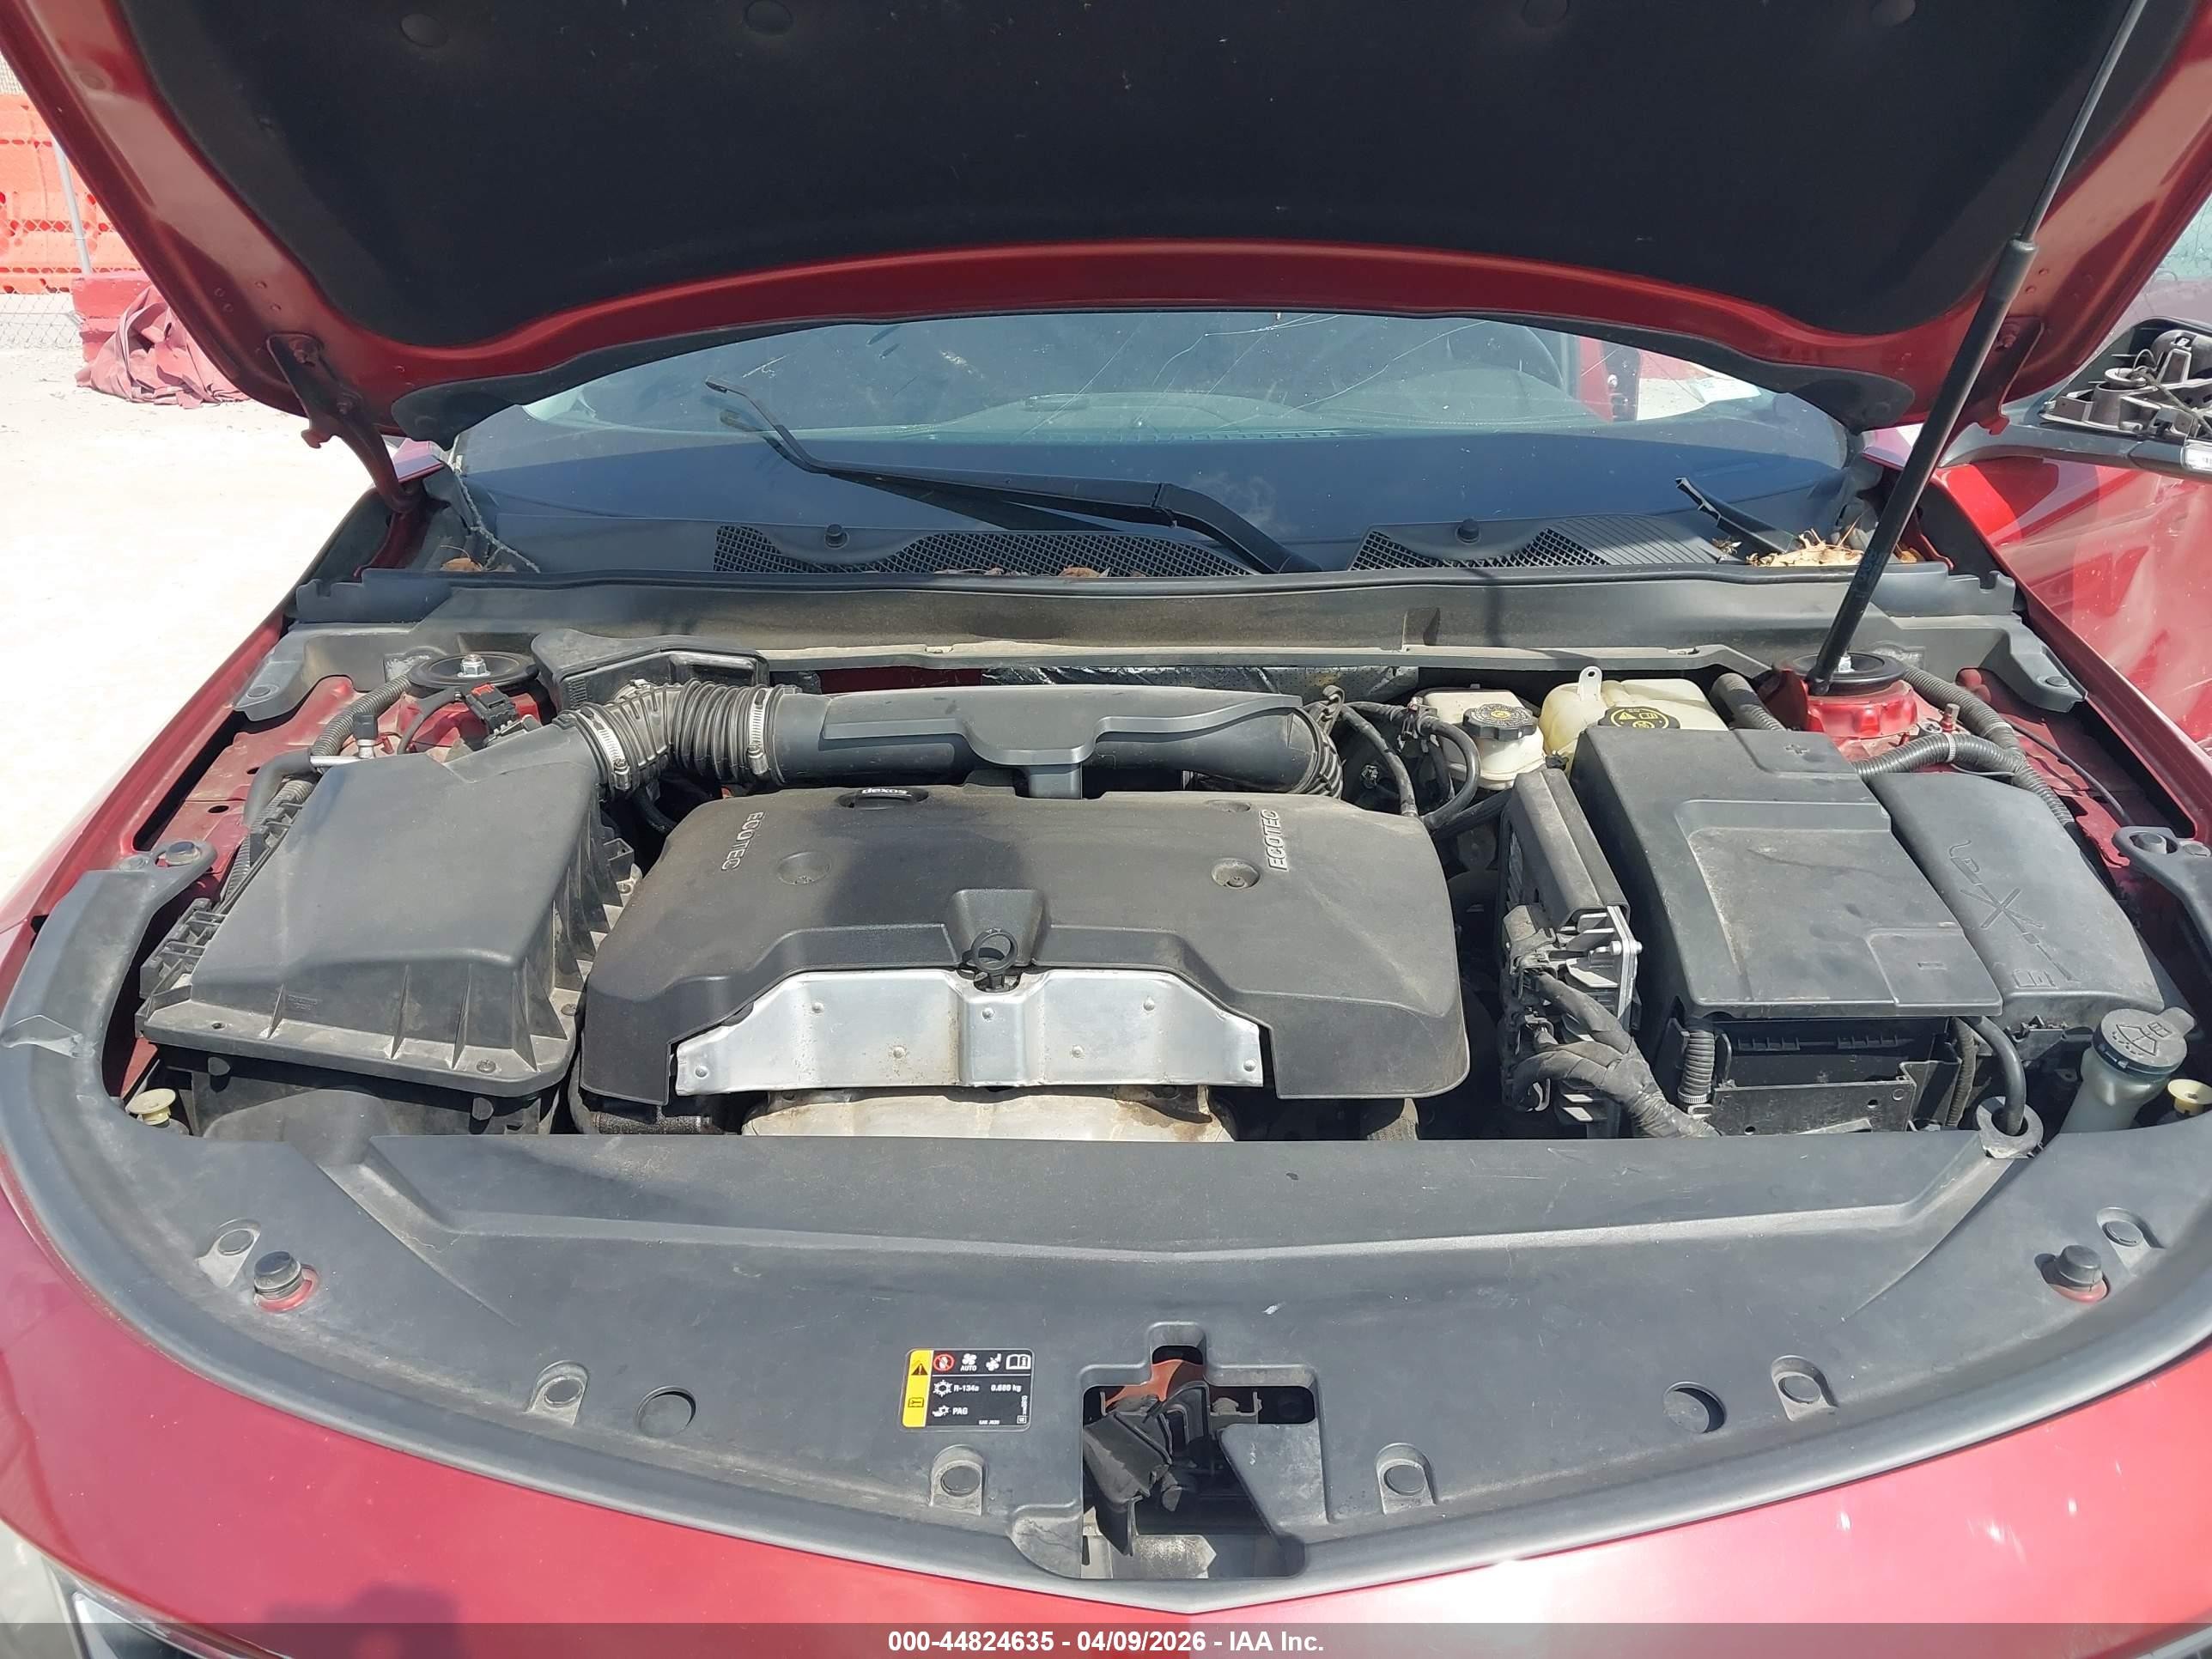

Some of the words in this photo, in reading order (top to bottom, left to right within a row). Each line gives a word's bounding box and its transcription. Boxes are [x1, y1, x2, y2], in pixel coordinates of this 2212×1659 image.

[721, 811, 764, 870] ECOTEC
[1260, 809, 1288, 871] ECOTEC
[1012, 1384, 1022, 1393] kg
